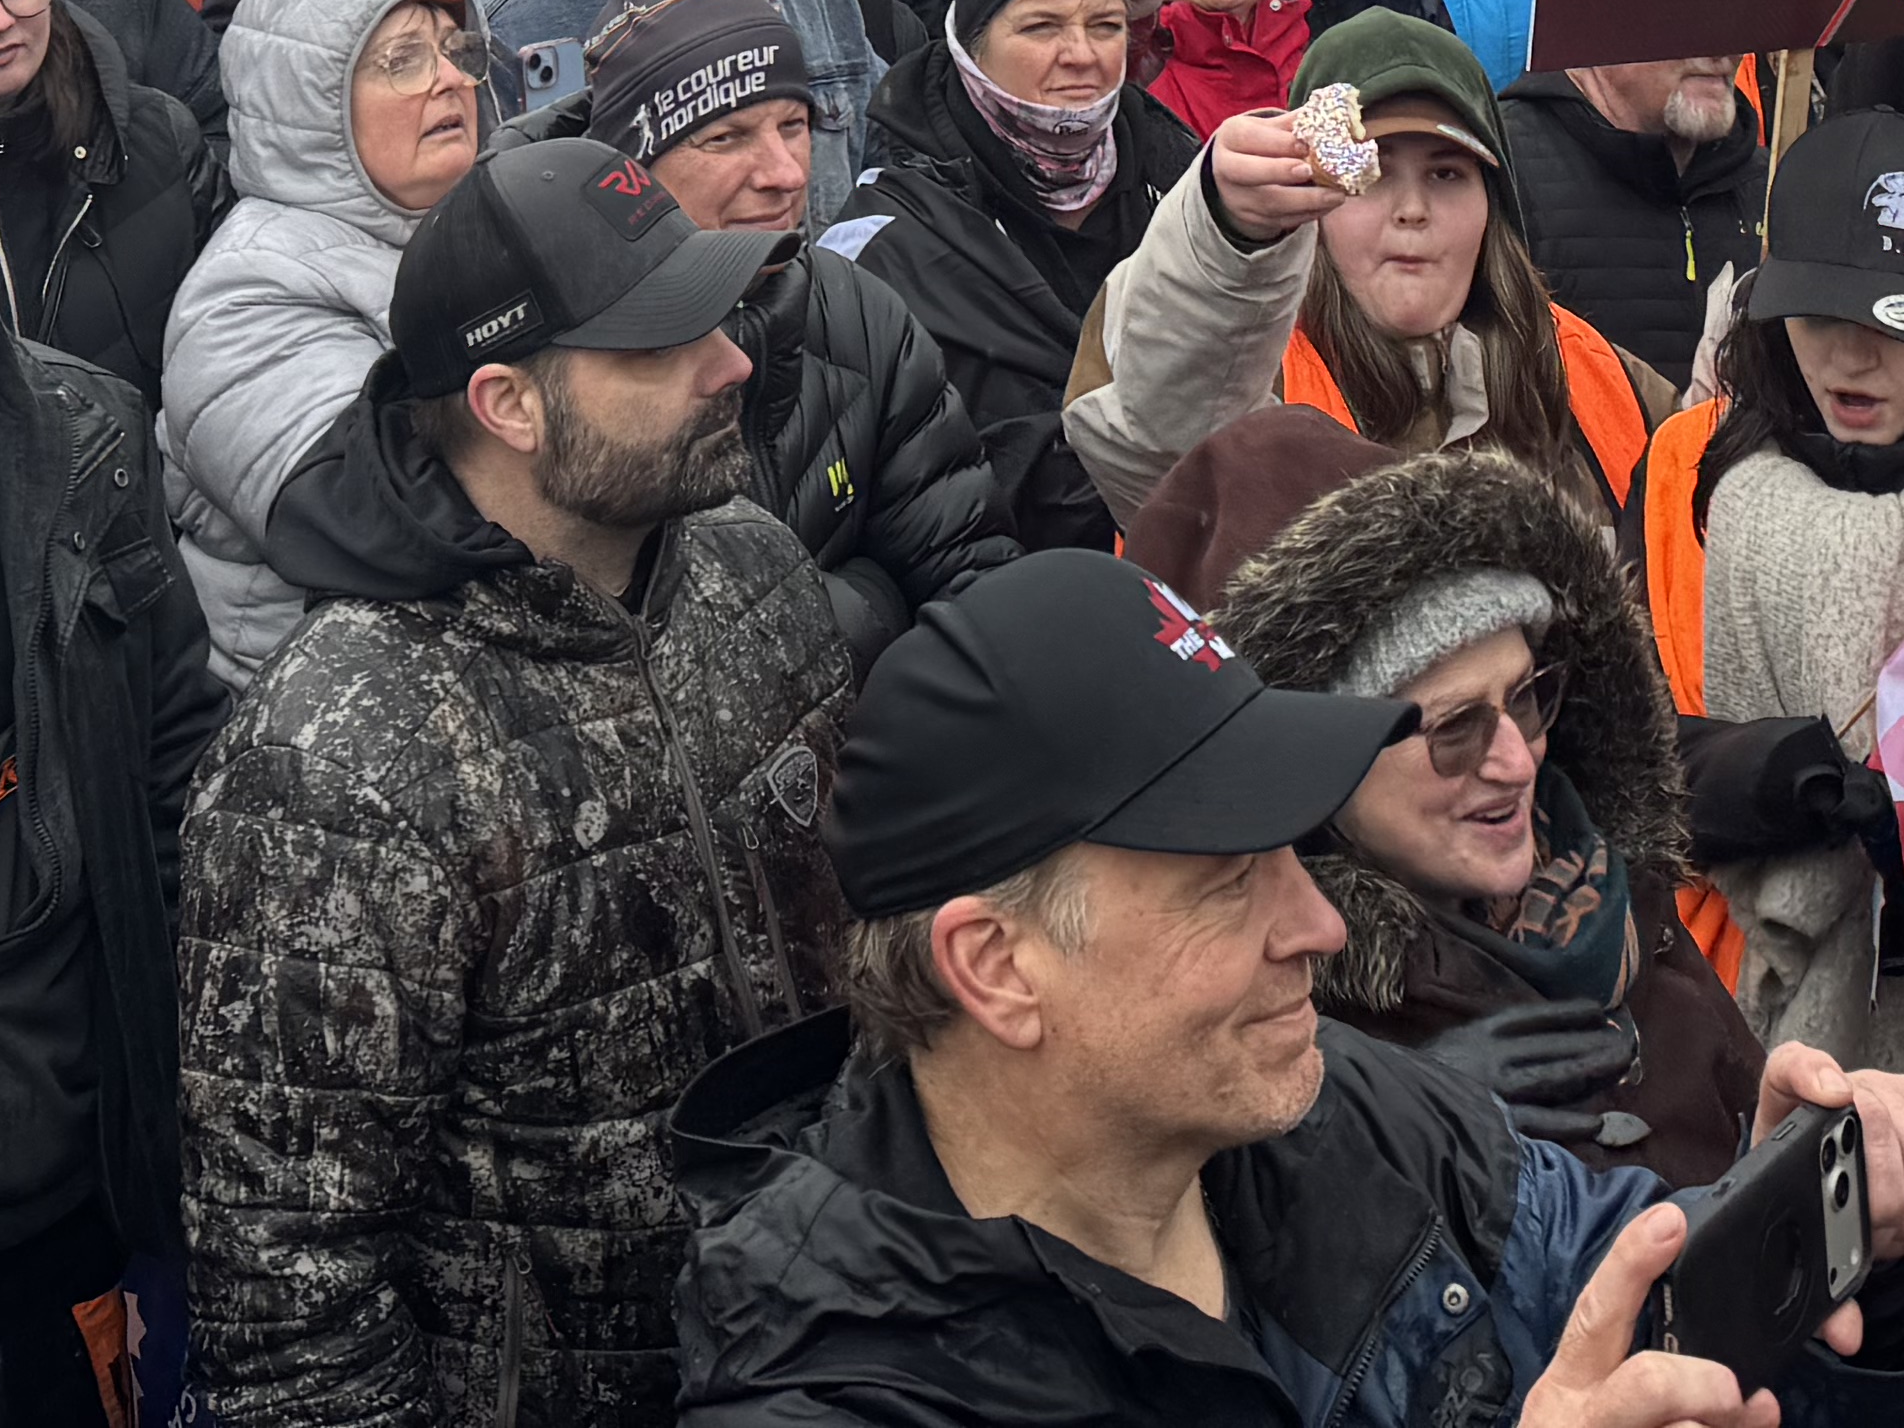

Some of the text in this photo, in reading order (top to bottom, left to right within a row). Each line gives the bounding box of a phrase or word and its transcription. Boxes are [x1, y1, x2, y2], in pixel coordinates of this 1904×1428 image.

[654, 44, 781, 116] le coureur
[660, 70, 767, 141] nordique
[465, 301, 528, 347] HOYT
